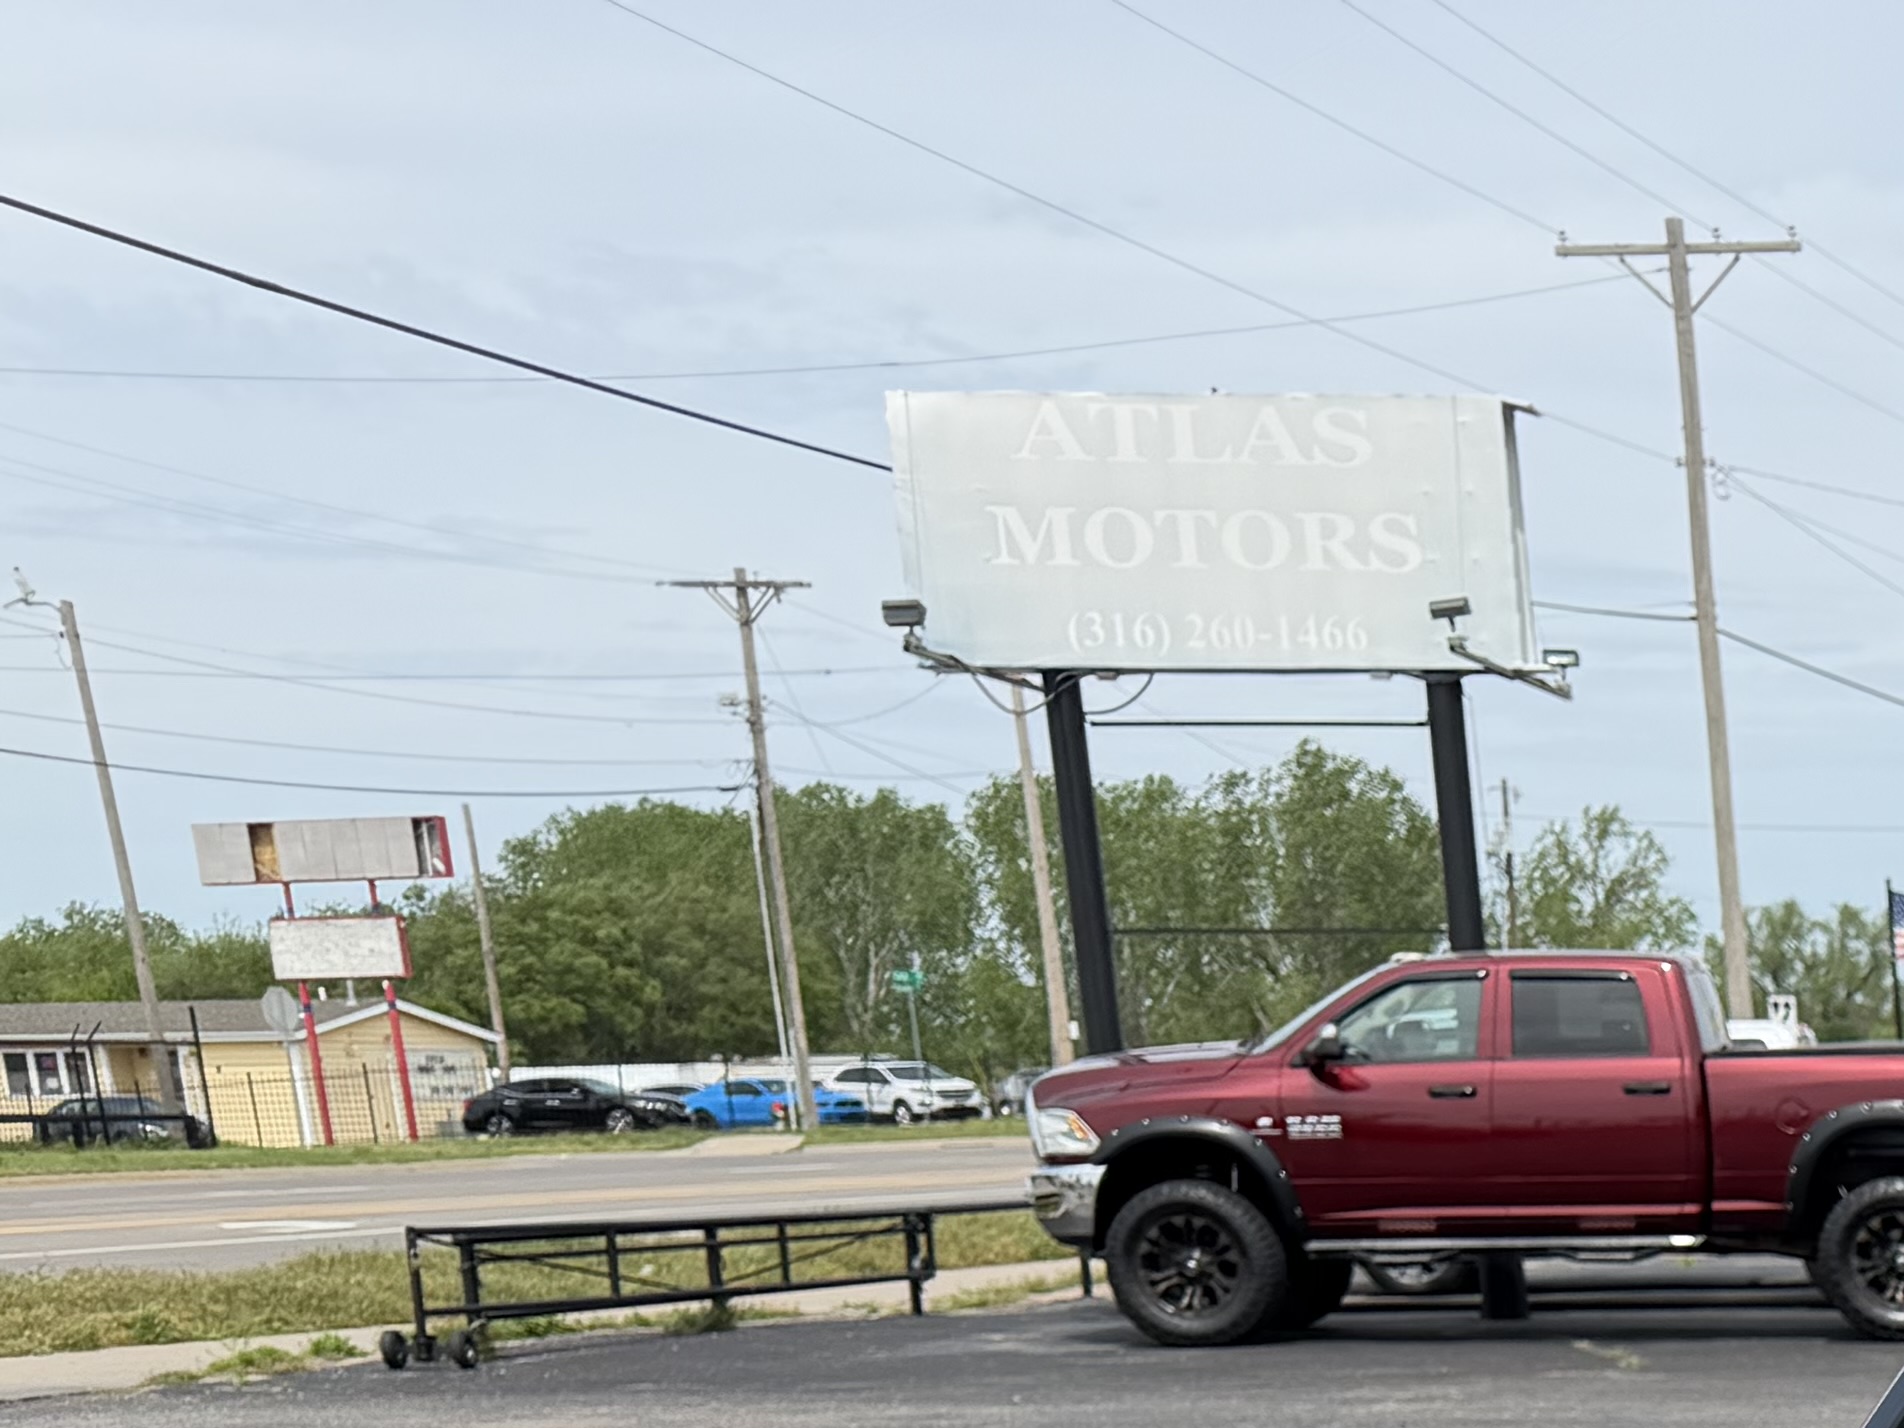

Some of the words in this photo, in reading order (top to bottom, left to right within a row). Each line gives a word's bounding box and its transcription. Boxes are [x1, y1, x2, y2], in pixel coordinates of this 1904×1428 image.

[1010, 398, 1374, 470] ATLAS
[984, 504, 1424, 575] MOTORS
[1066, 611, 1172, 657] (316)
[1186, 612, 1368, 652] 260-1466
